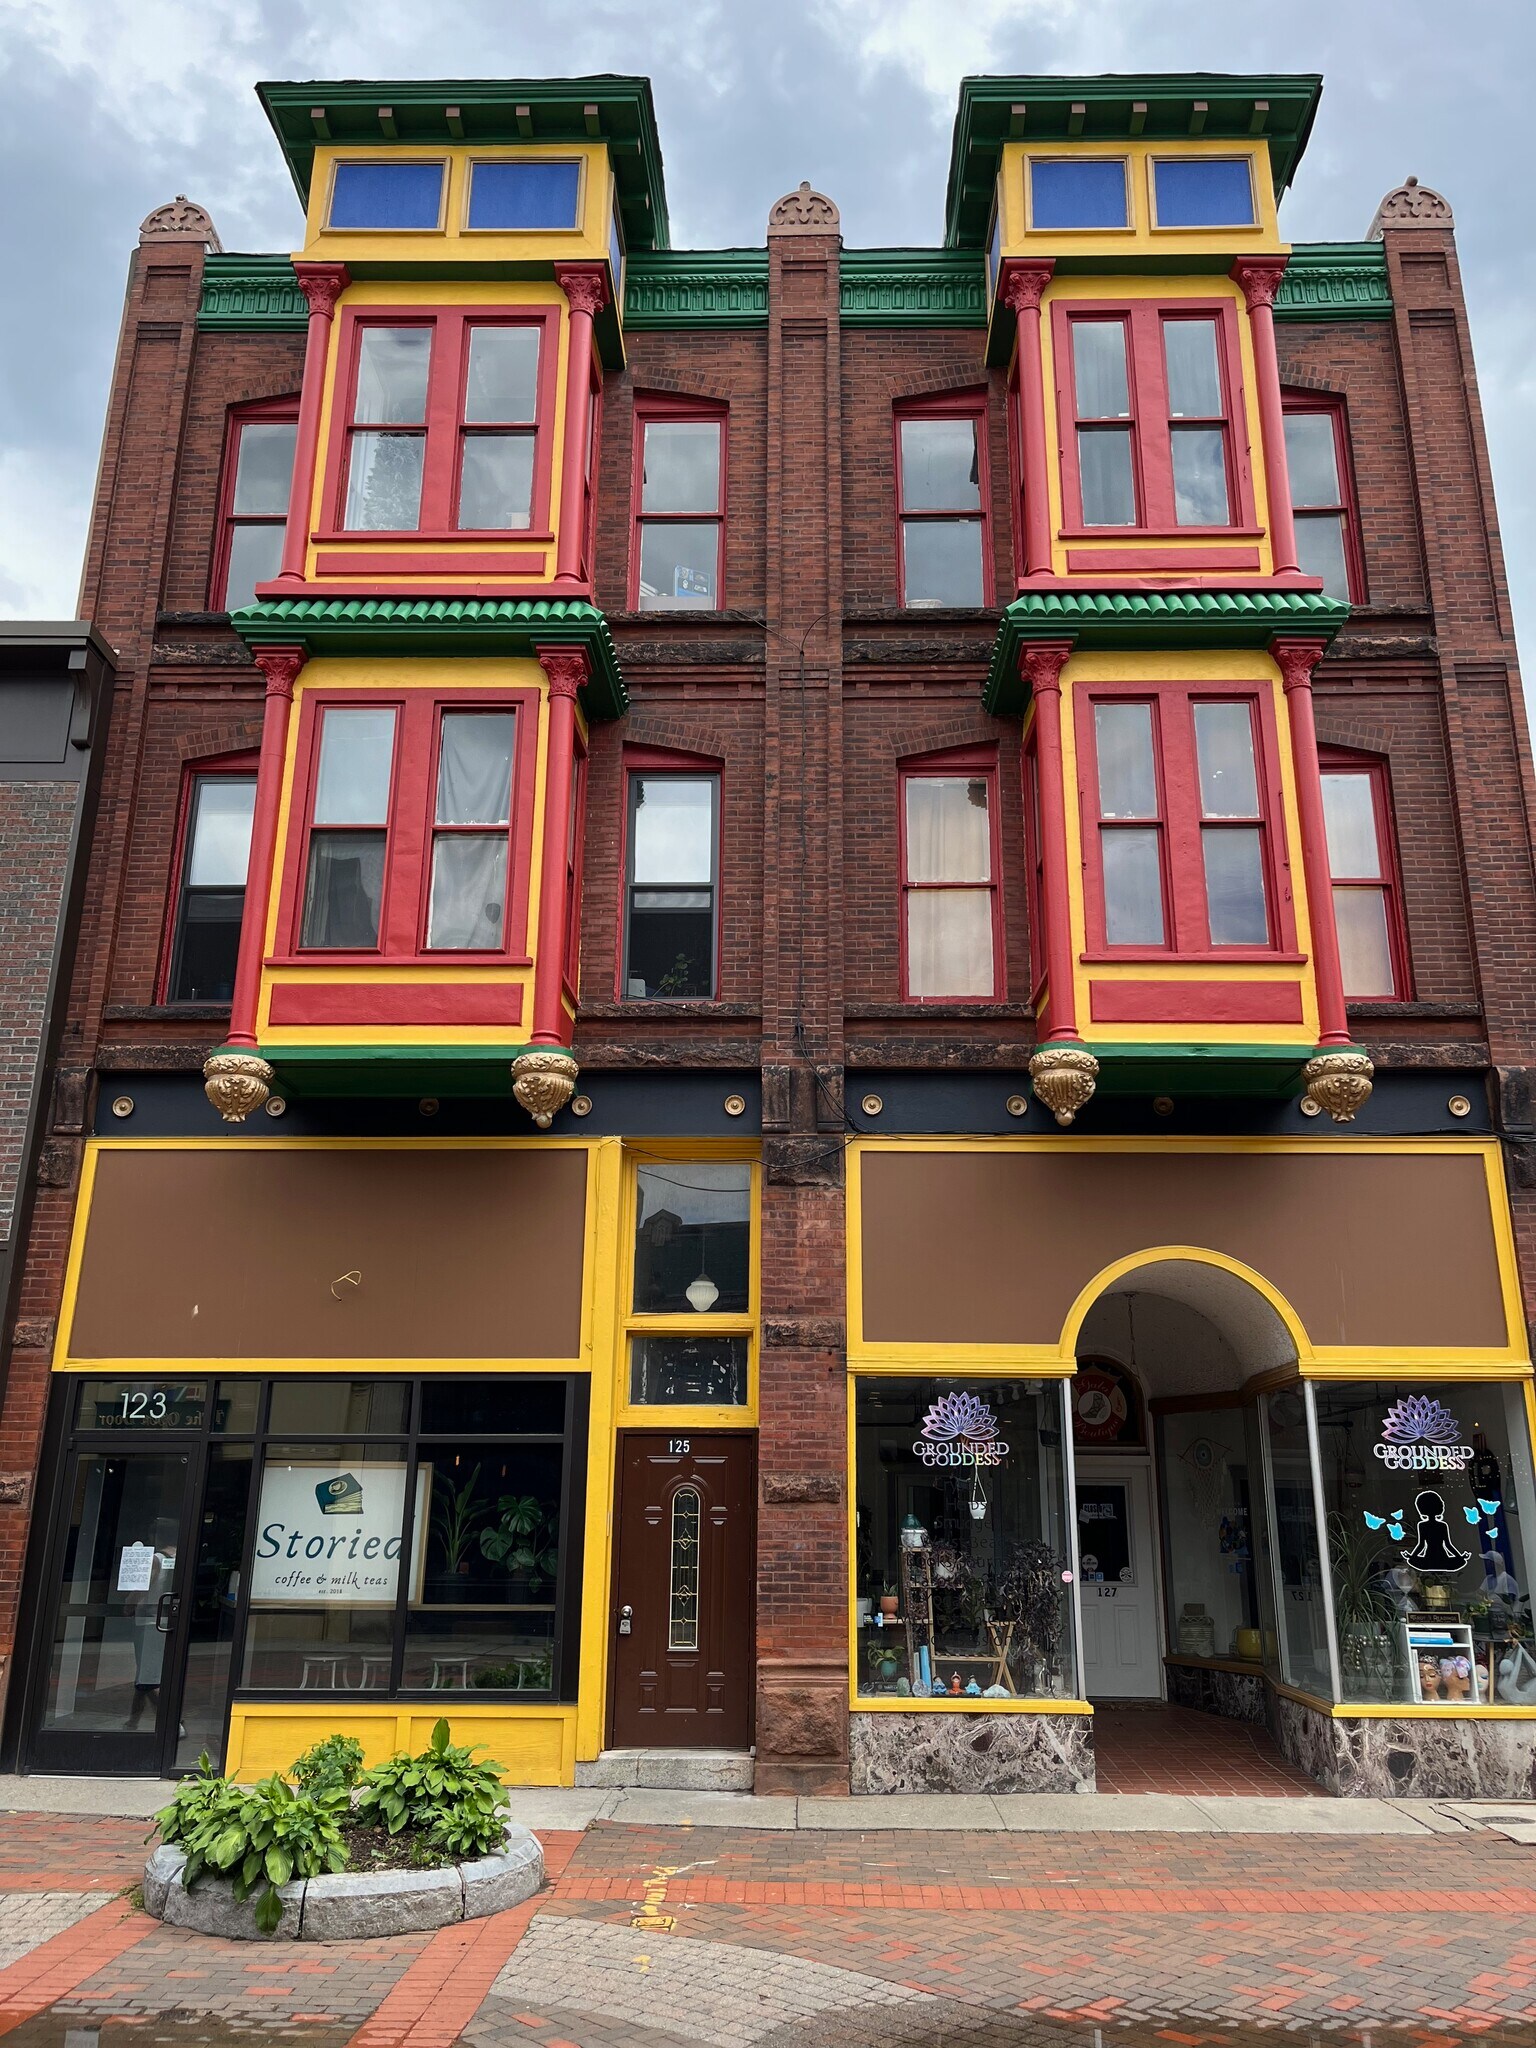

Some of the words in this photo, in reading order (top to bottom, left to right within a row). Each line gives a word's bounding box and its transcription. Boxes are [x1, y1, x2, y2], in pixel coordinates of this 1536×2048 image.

[120, 1391, 167, 1420] 123
[668, 1440, 690, 1453] 125
[912, 1441, 1010, 1457] GROUNDED
[1373, 1443, 1475, 1460] GROUNDED
[922, 1453, 1002, 1467] GODDESS
[1384, 1455, 1466, 1470] GODDESS
[275, 1571, 312, 1587] coffee
[316, 1574, 327, 1585] &
[331, 1572, 361, 1589] milk
[364, 1576, 388, 1585] teas
[1097, 1587, 1118, 1598] 127
